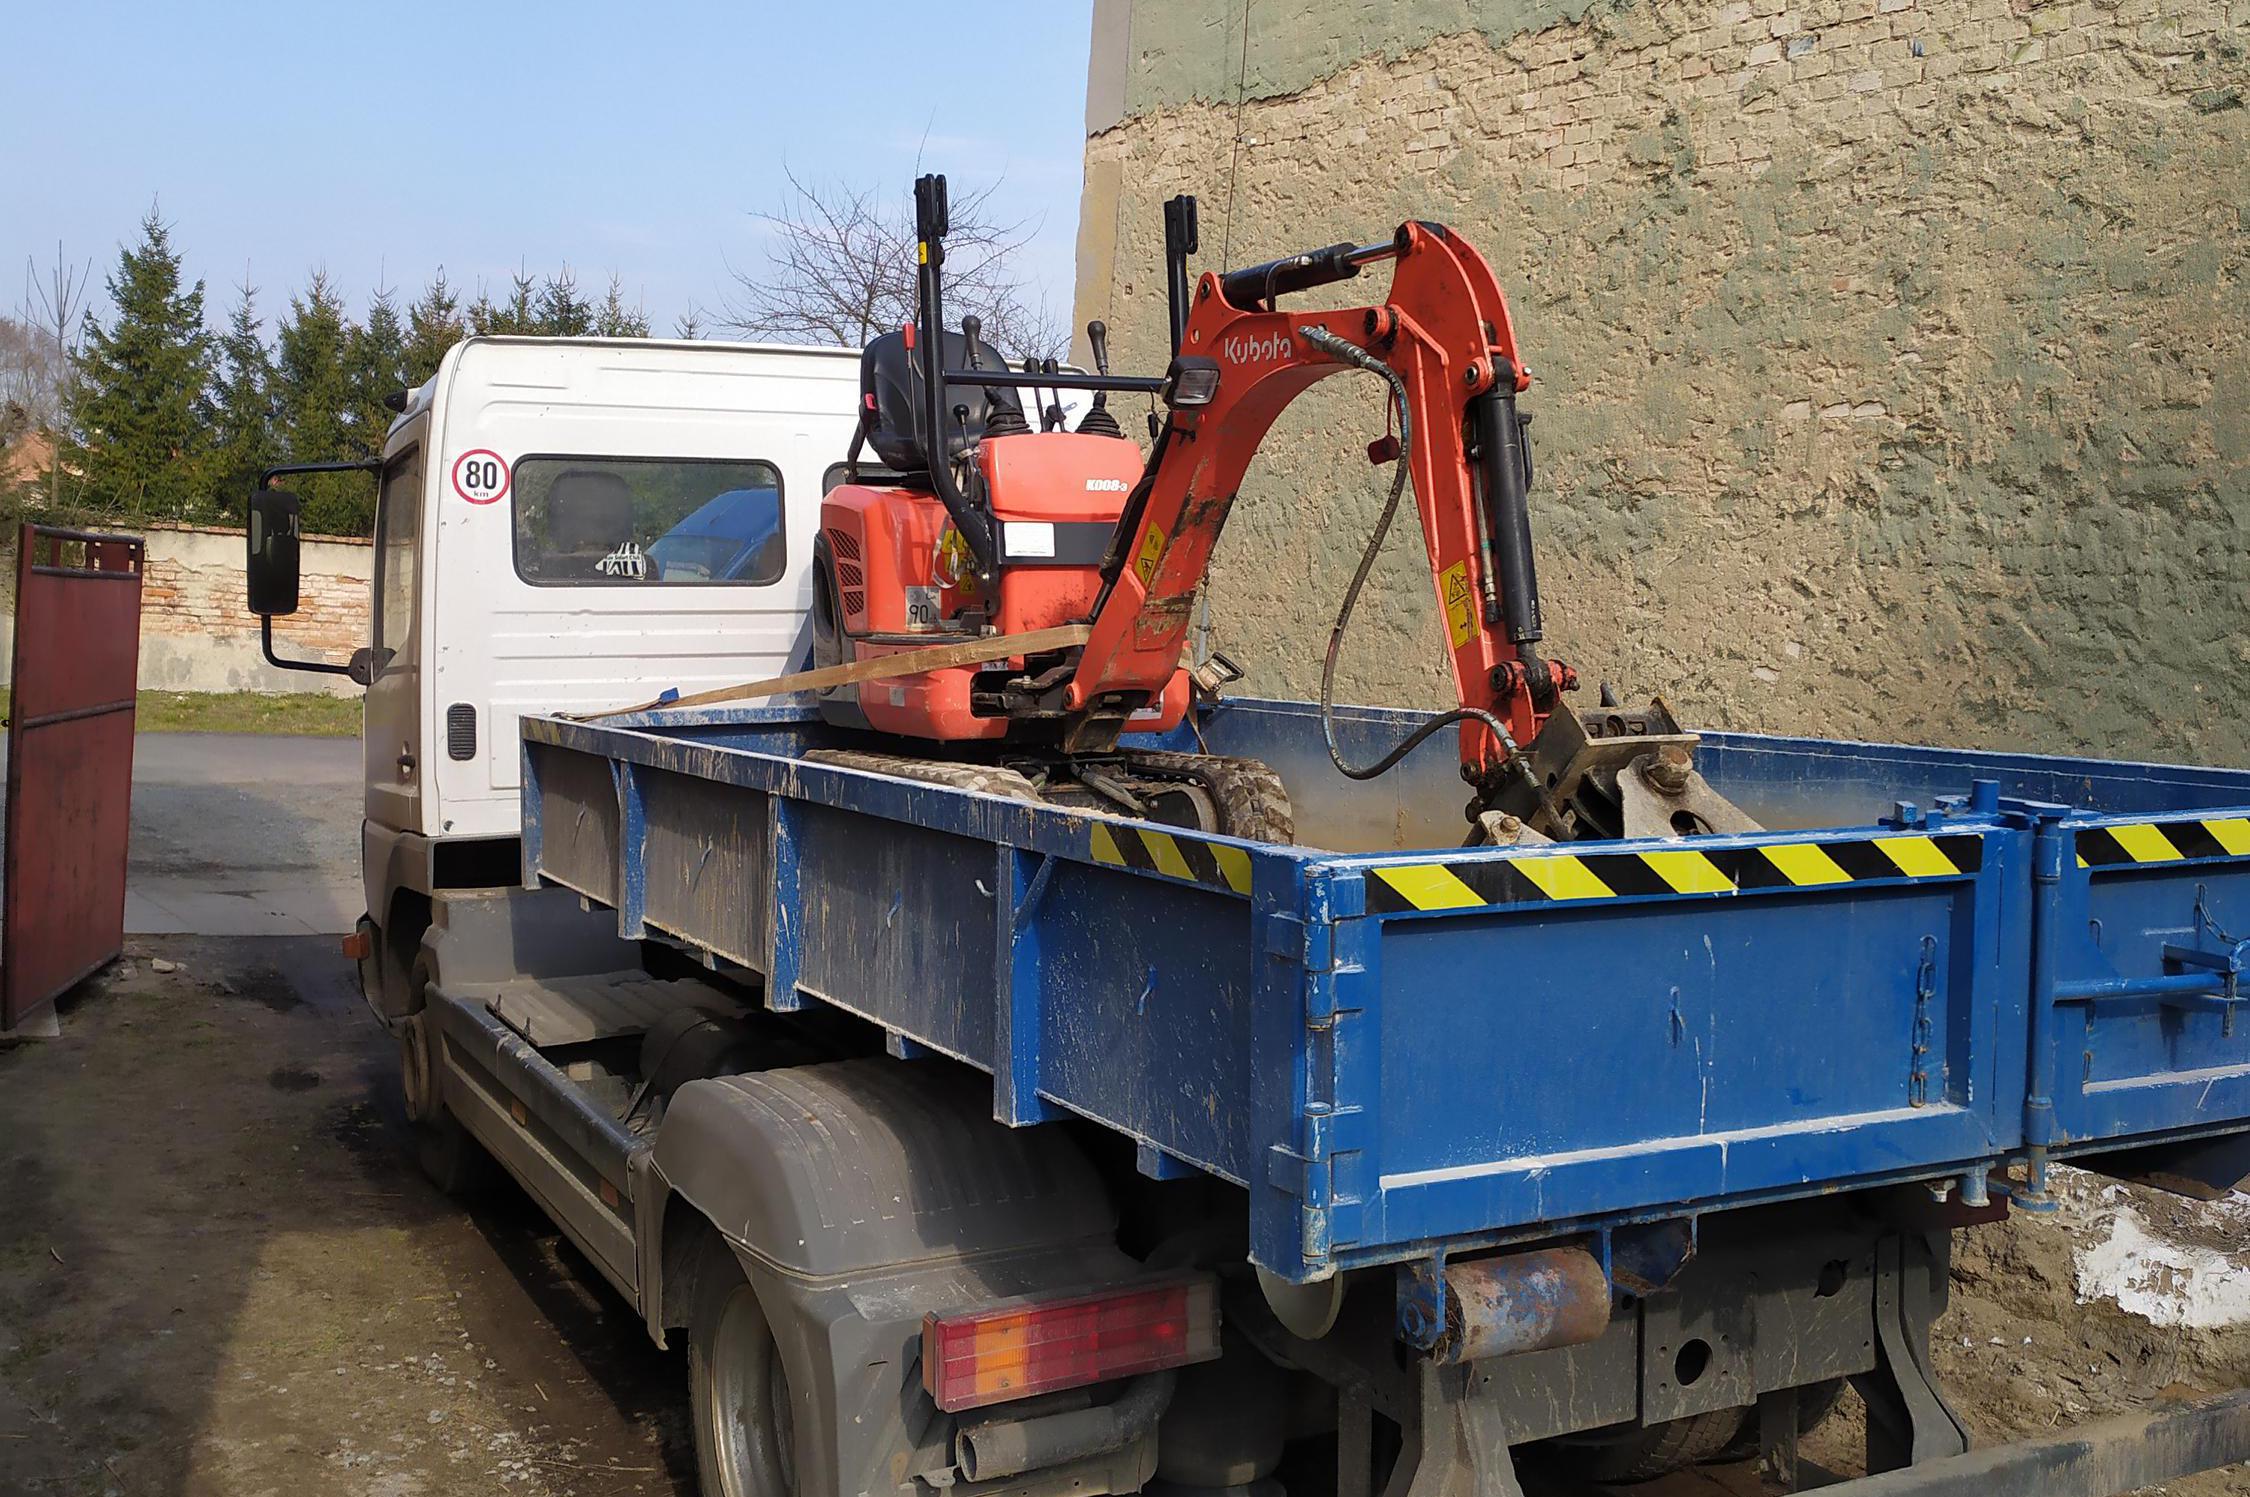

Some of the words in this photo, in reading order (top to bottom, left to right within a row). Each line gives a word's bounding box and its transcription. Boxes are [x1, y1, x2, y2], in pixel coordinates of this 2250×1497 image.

[1224, 331, 1291, 365] Kubota
[465, 461, 497, 490] 80
[1086, 479, 1128, 492] K008-3
[473, 490, 489, 498] km
[909, 604, 929, 625] 90
